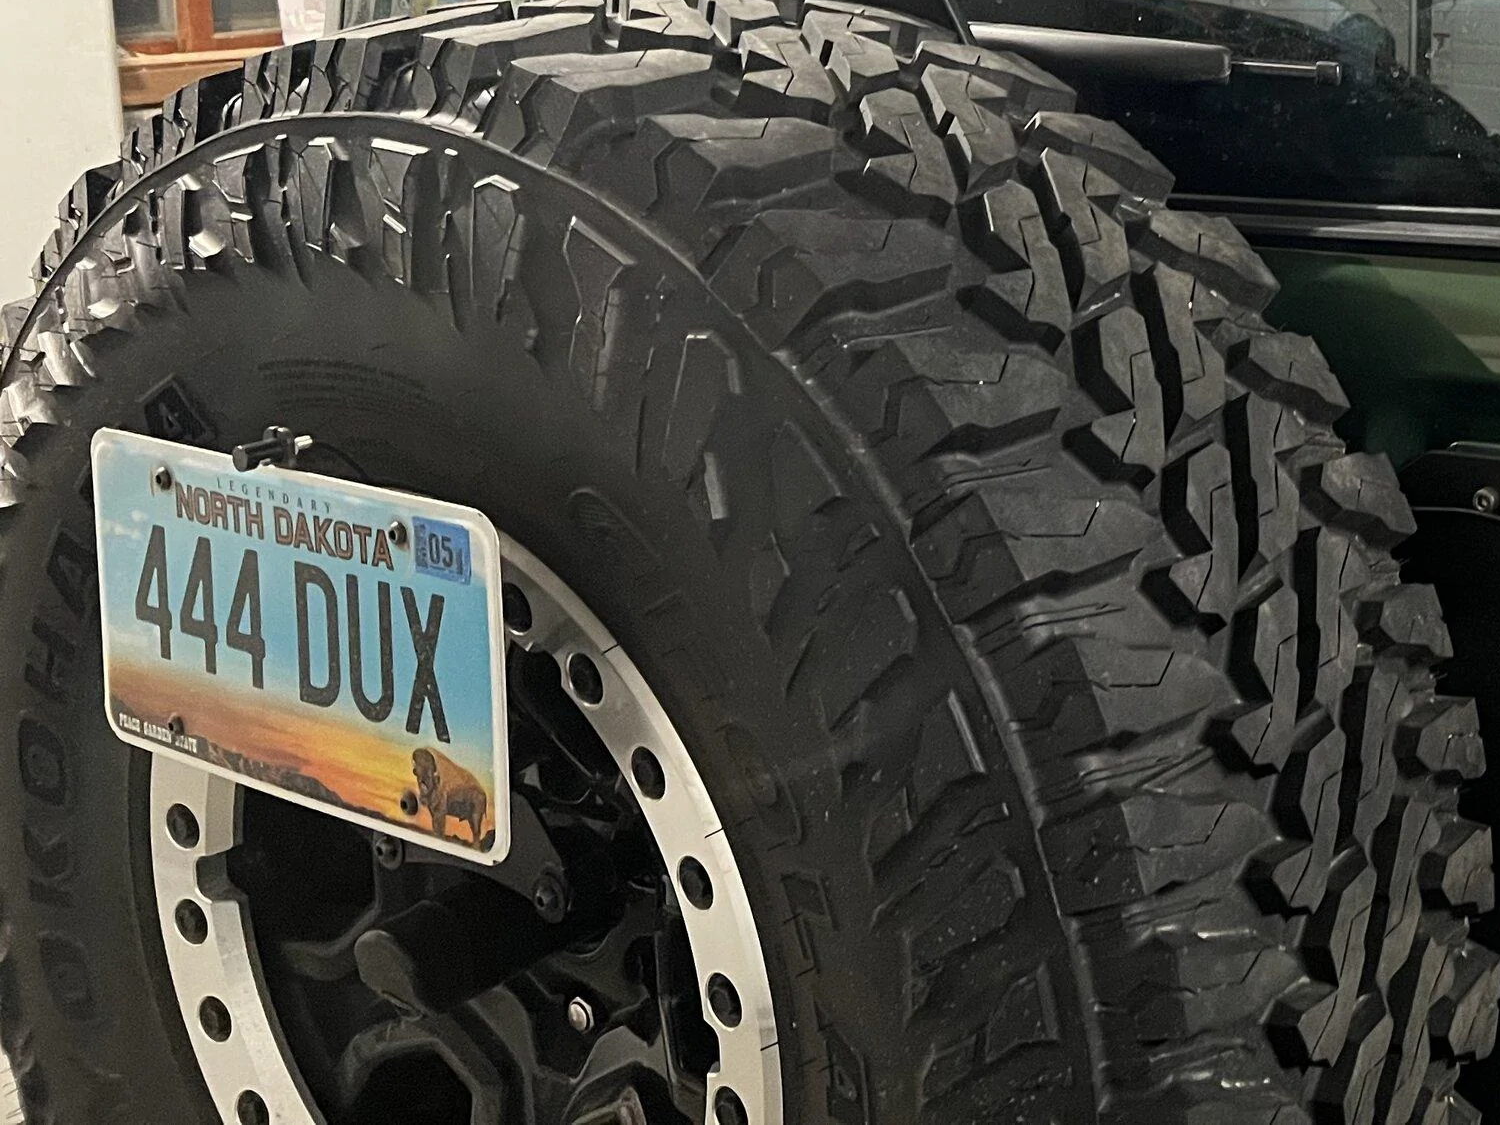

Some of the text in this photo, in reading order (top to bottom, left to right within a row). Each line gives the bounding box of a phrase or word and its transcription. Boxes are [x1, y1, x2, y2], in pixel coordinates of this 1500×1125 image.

[175, 481, 264, 540] NORTH
[273, 505, 394, 571] DAKOTA
[216, 478, 332, 513] LEGENDARY
[428, 532, 453, 568] 05
[135, 524, 451, 743] 444 DUX
